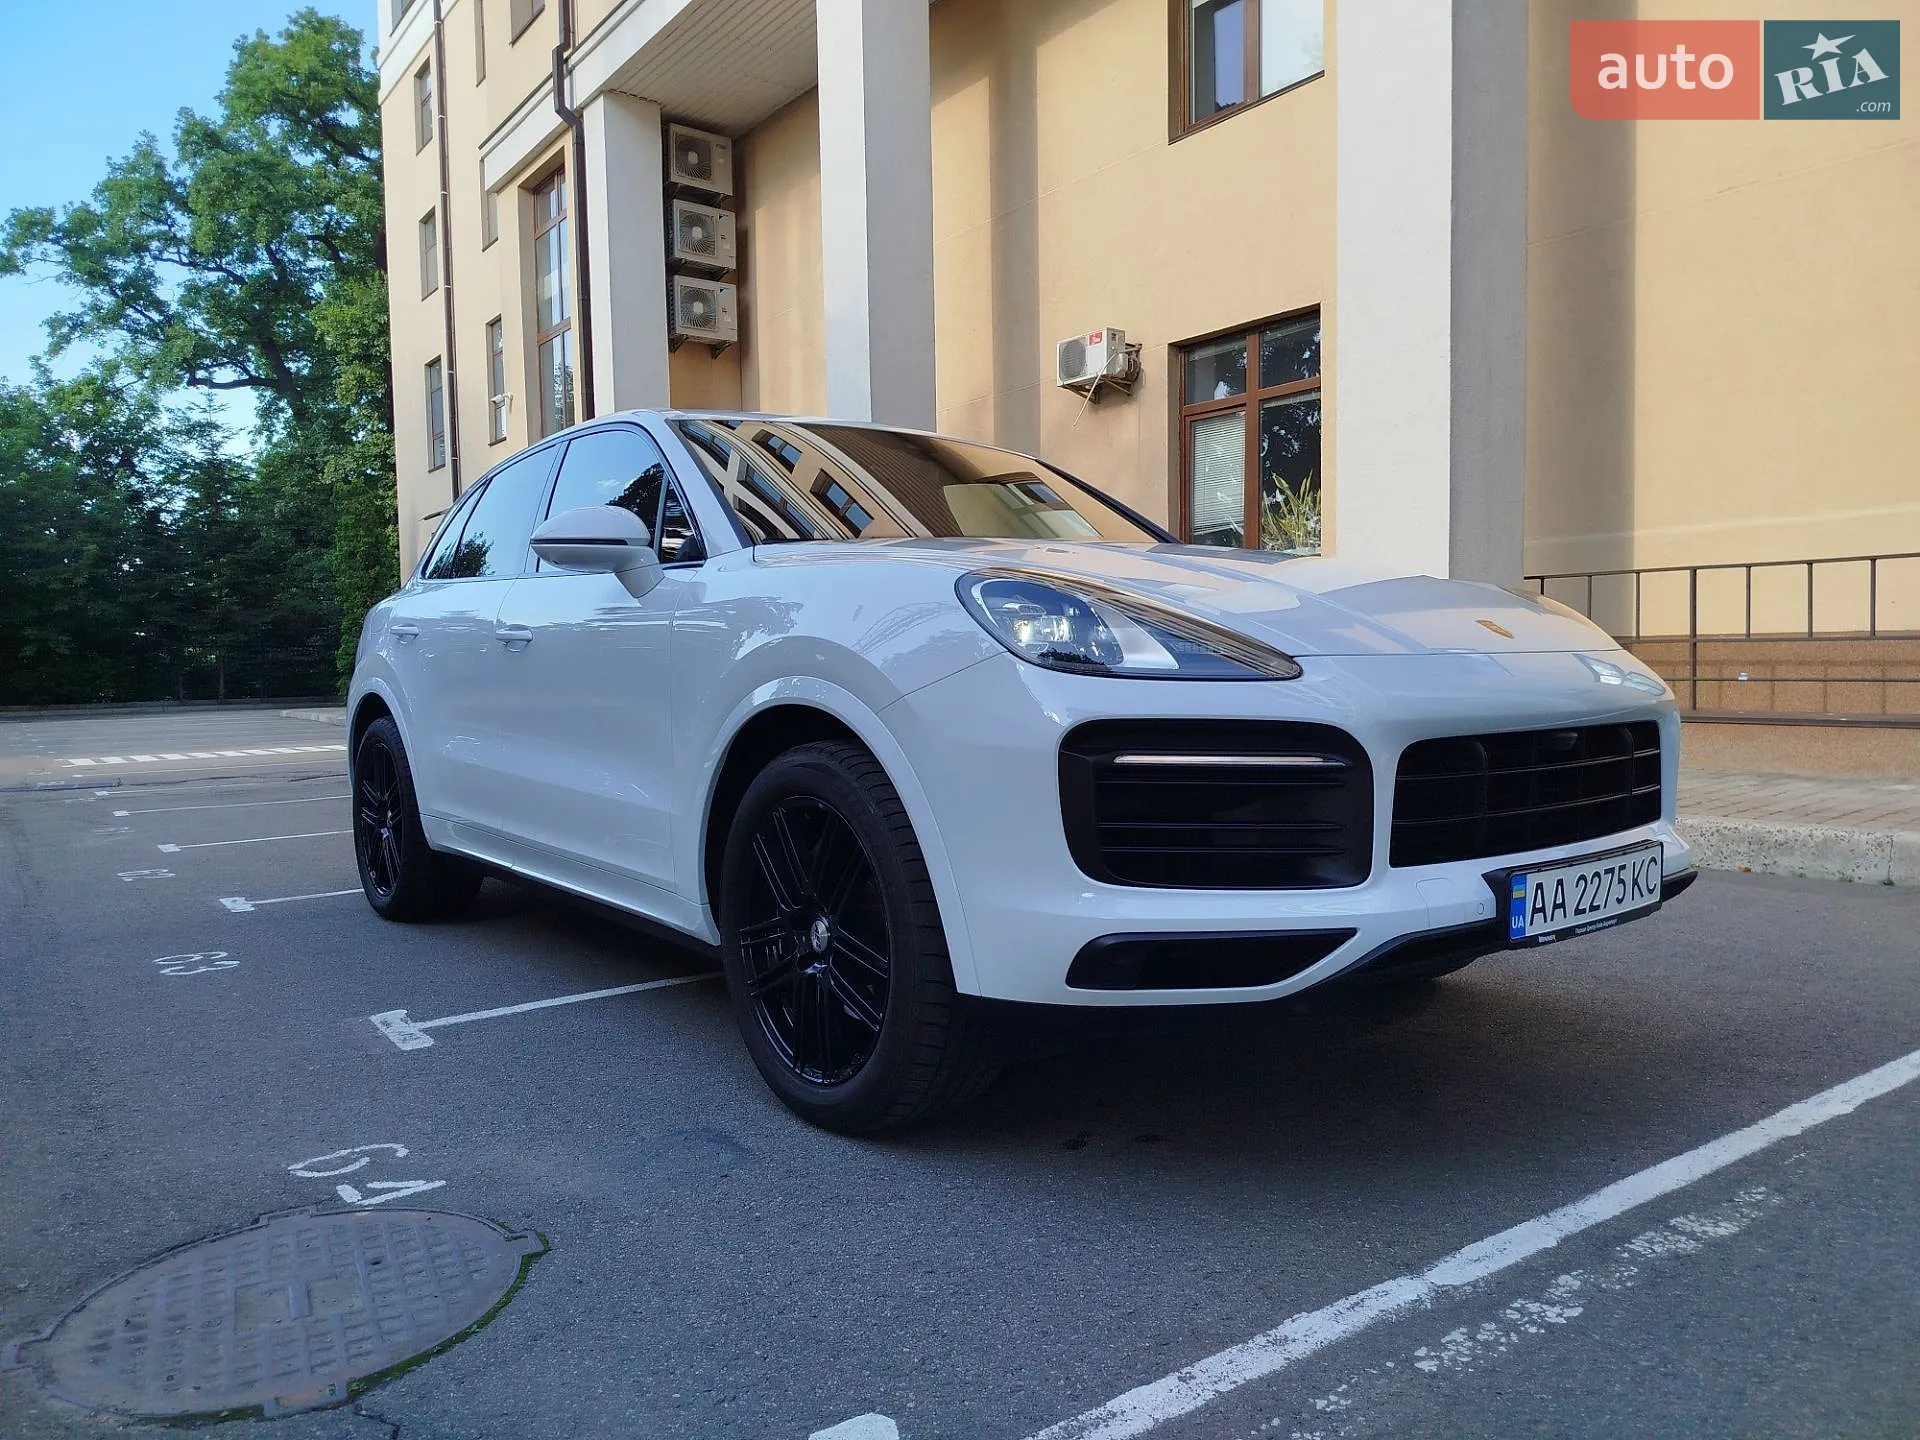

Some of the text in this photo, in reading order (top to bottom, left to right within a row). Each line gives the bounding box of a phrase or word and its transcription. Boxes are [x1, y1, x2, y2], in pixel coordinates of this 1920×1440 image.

[1529, 856, 1658, 927] AA 2275 KC
[1511, 914, 1525, 929] UA
